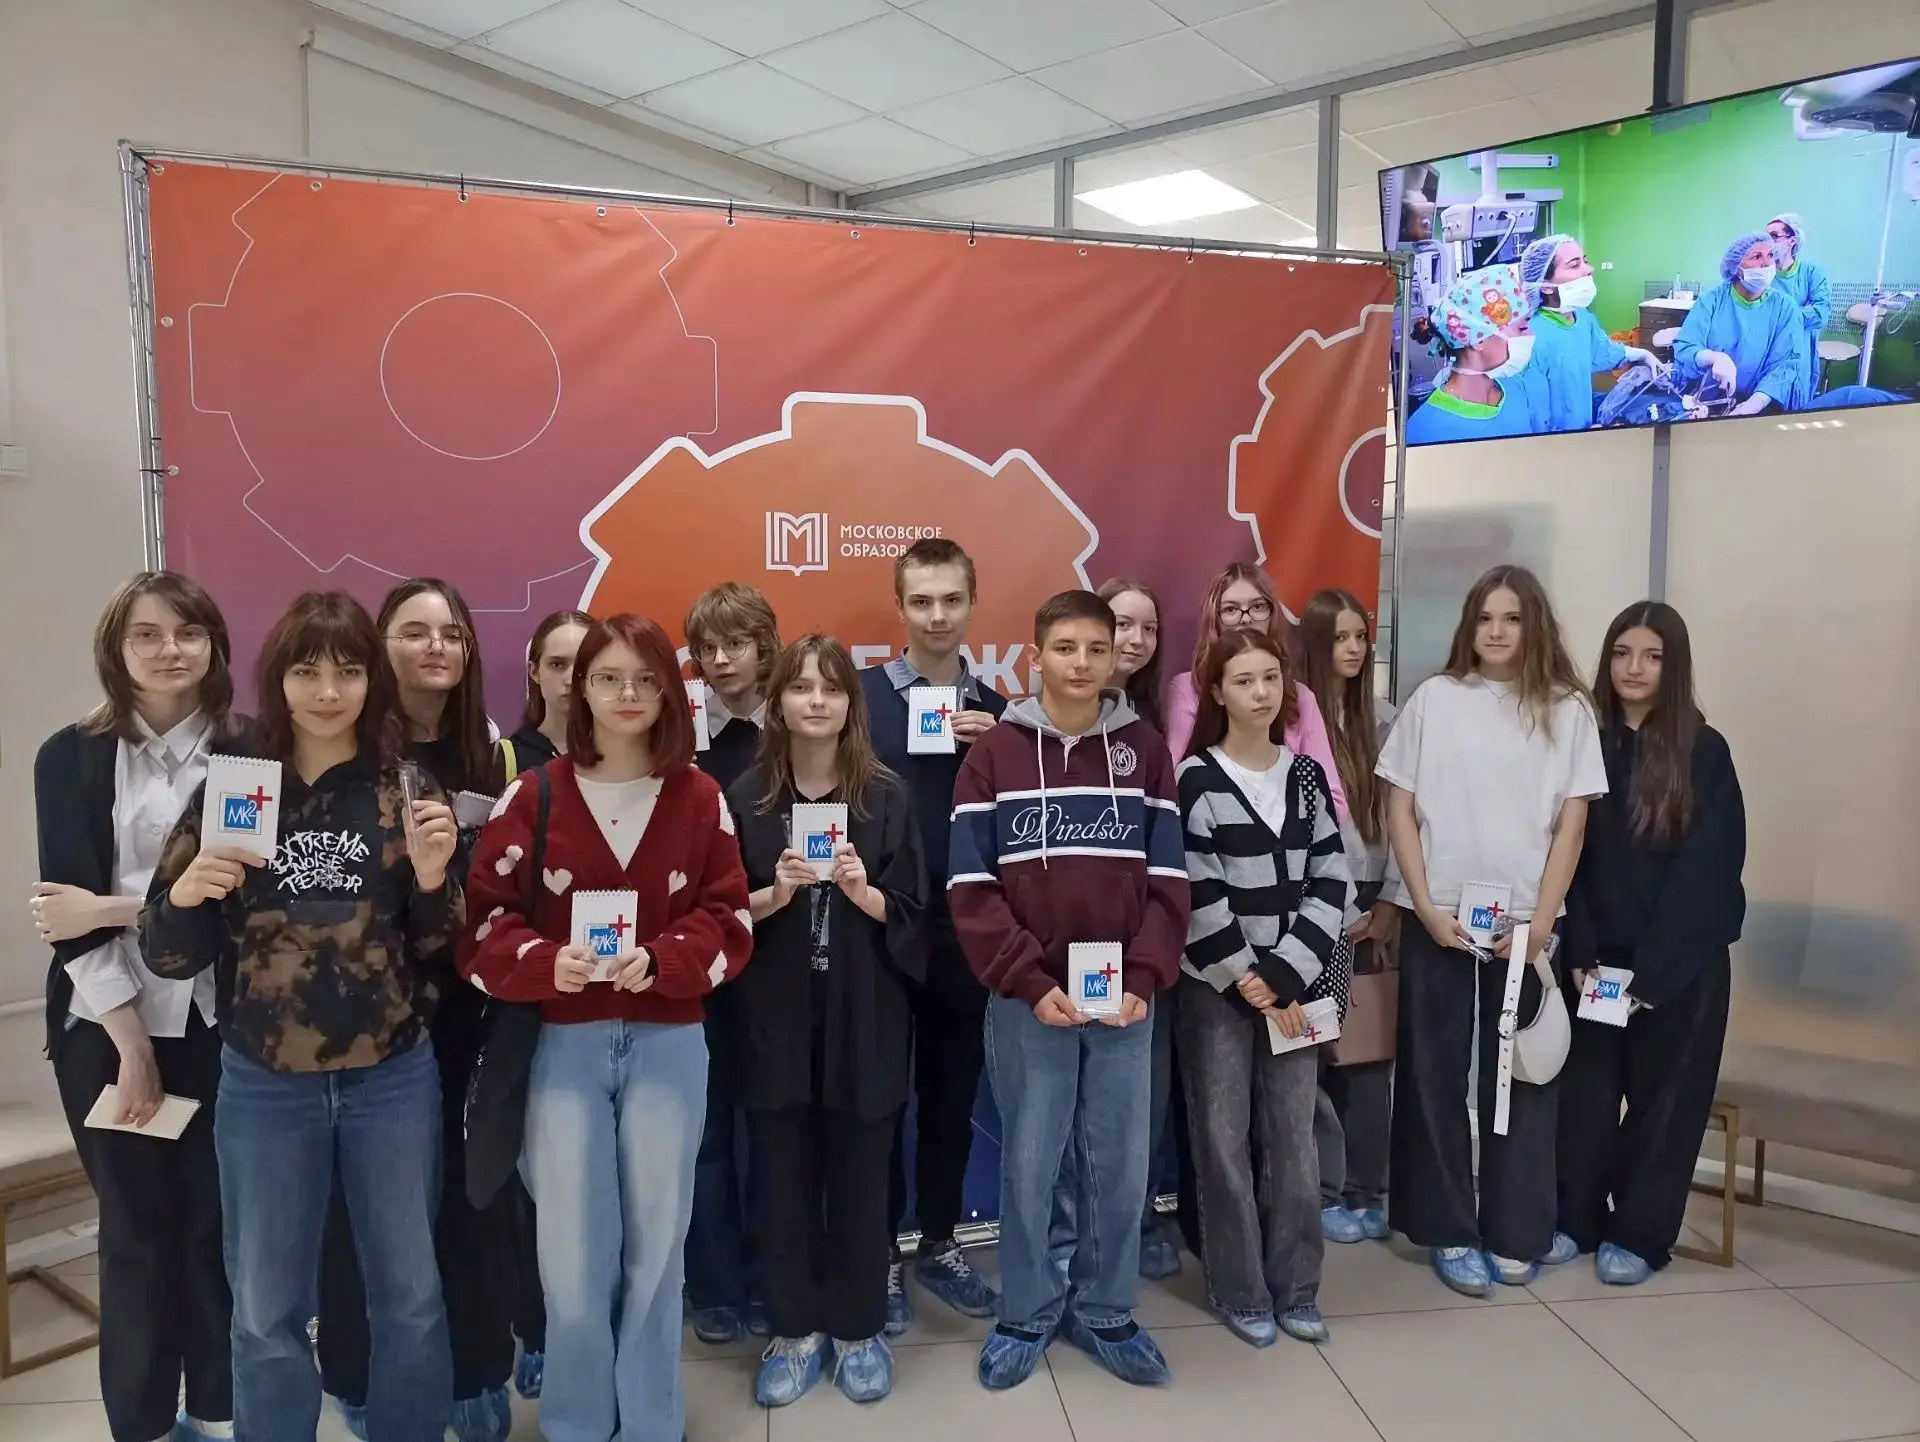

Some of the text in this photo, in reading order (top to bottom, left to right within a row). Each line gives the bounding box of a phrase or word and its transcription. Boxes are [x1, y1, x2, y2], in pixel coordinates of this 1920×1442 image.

[840, 524, 943, 540] МОСКОВСКОЕ
[840, 543, 906, 558] ОБРАЗОВ
[1007, 804, 1138, 845] Windsor
[292, 851, 345, 874] NOISE
